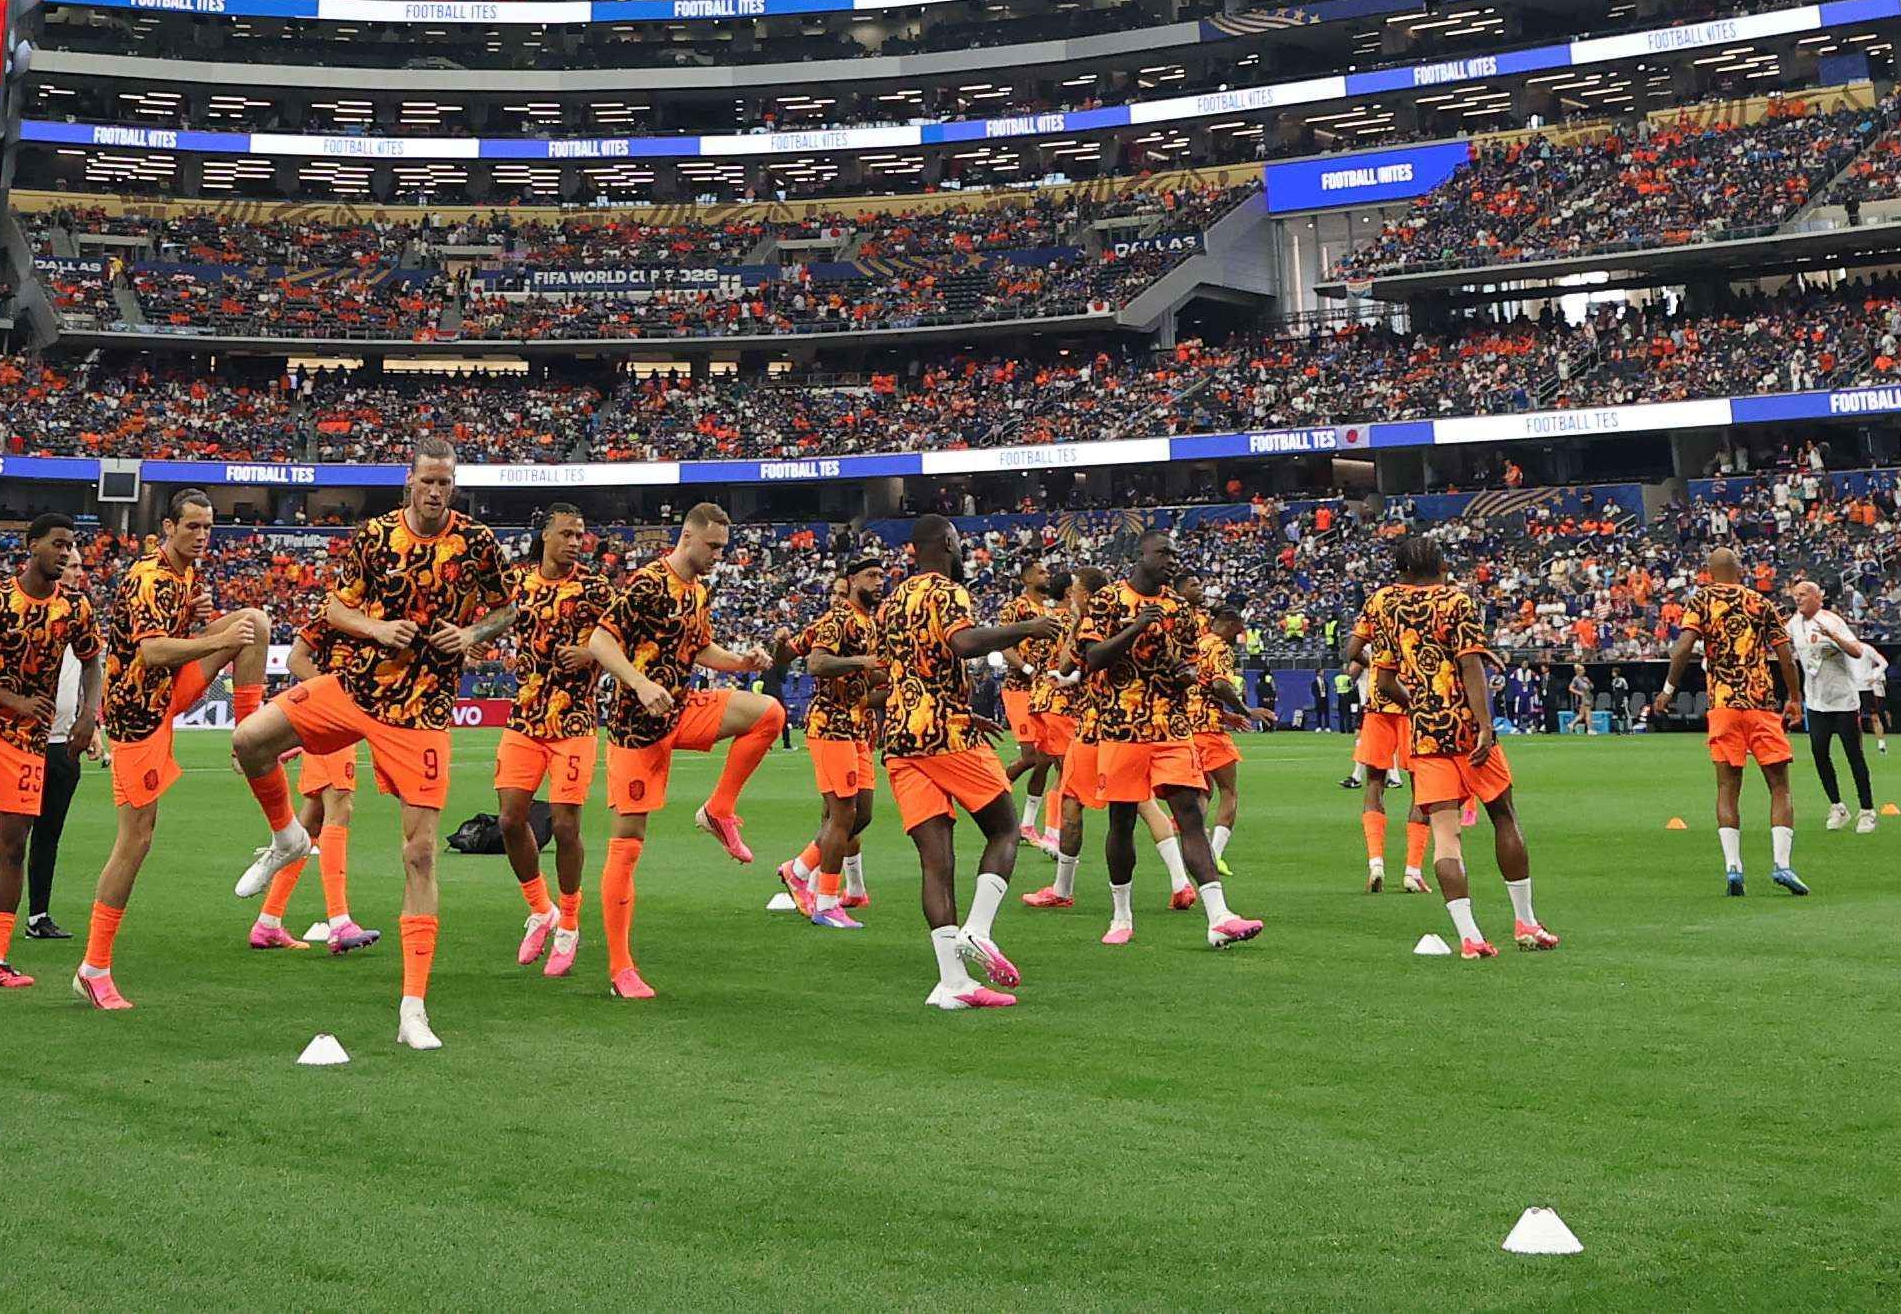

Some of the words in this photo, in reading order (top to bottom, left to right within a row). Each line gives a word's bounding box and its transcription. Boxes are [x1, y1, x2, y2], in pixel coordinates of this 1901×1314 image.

[405, 4, 466, 20] FOOTBALL
[1648, 26, 1705, 50] FOOTBALL
[1414, 61, 1467, 85] FOOTBALL
[1198, 92, 1246, 112] FOOTBALL
[93, 126, 147, 147] FOOTBALL
[986, 118, 1029, 137] FOOTBALL
[323, 139, 373, 155] FOOTBALL
[548, 140, 598, 157] FOOTBALL
[771, 134, 819, 151] FOOTBALL
[34, 259, 102, 272] DALLAS
[534, 271, 567, 285] FIFA
[569, 270, 627, 284] WORLD
[1526, 414, 1590, 433] FOOTBALL
[1249, 432, 1311, 453] FOOTBALL
[999, 449, 1054, 466] FOOTBALL
[226, 466, 289, 483] FOOTBALL
[499, 468, 560, 482] FOOTBALL
[760, 461, 817, 479] FOOTBALL
[424, 748, 438, 780] 9
[567, 755, 580, 782] 5
